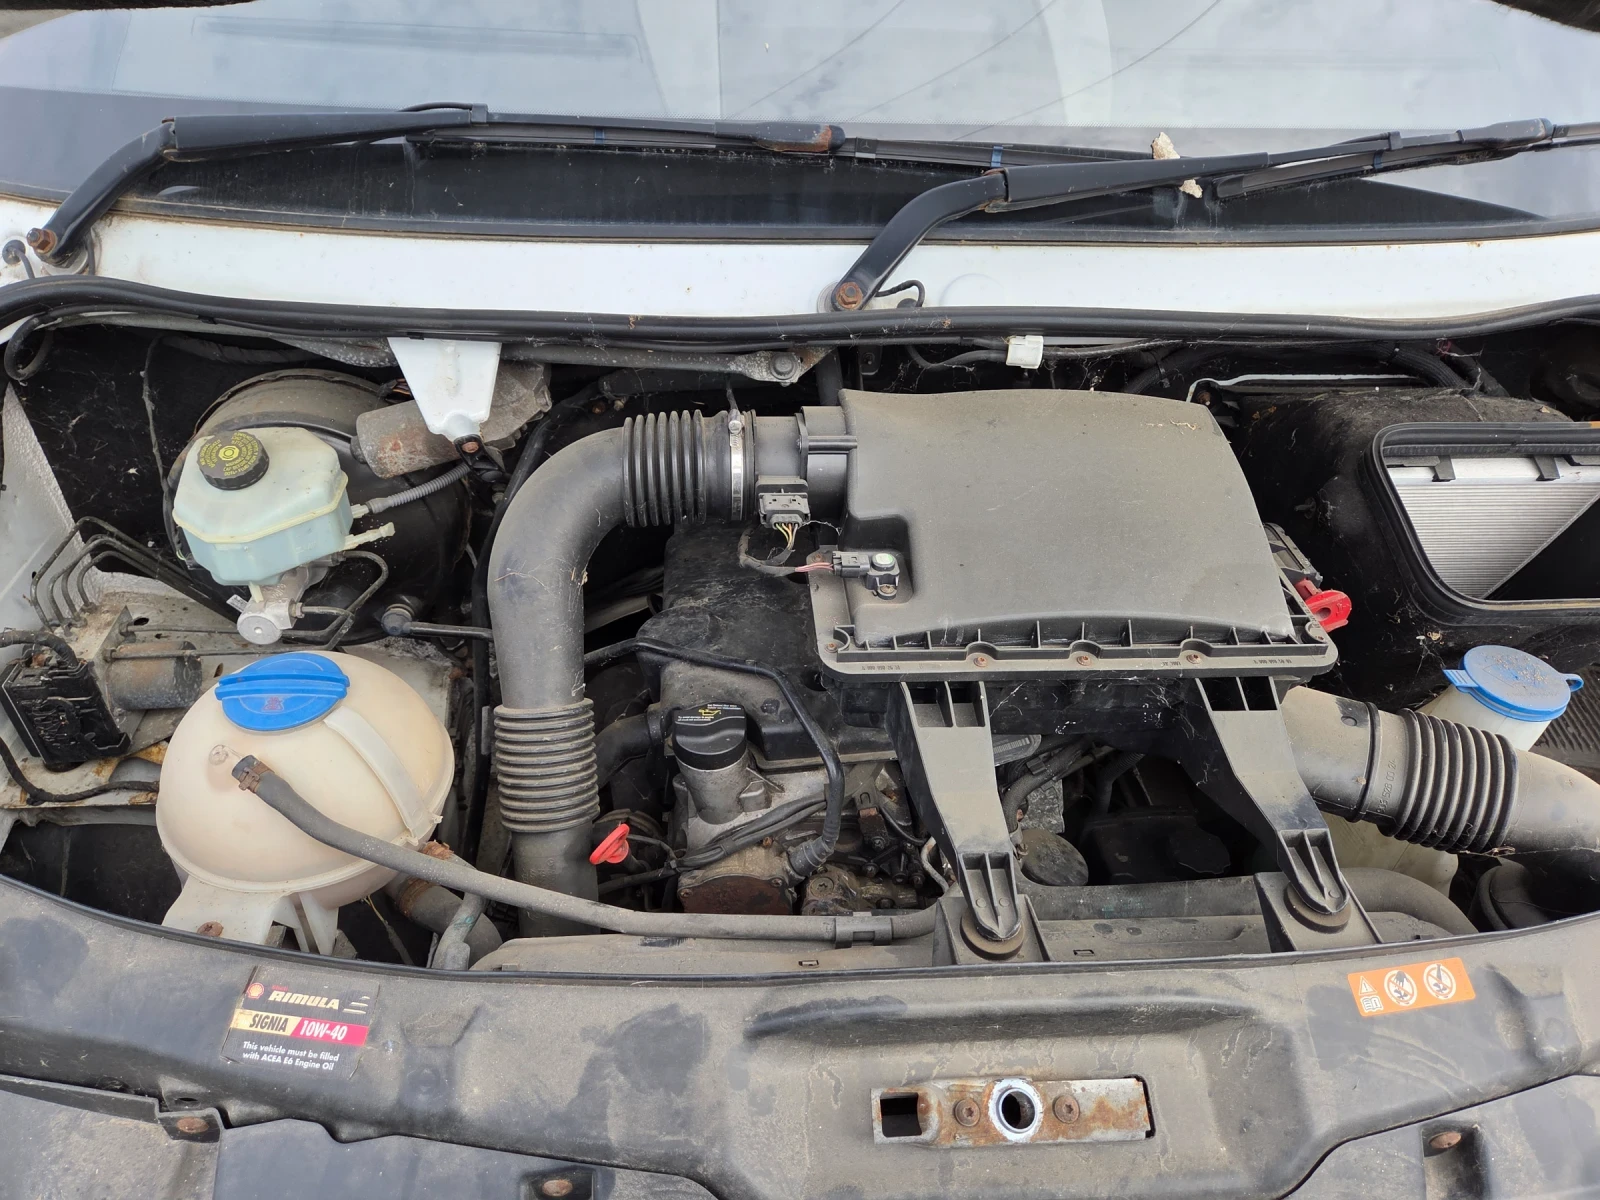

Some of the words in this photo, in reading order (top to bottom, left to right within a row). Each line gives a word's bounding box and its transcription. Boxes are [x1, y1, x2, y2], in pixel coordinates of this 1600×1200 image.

[268, 990, 340, 1010] RIMULA
[249, 1013, 289, 1032] SIGNIA
[299, 1020, 348, 1041] 10W-40
[242, 1051, 260, 1060] with
[261, 1053, 282, 1063] ACEA
[283, 1056, 293, 1065] E6
[294, 1059, 321, 1069] Engine
[322, 1062, 334, 1071] Oil
[243, 1041, 258, 1050] This
[260, 1044, 286, 1054] vehicle
[287, 1048, 307, 1057] must
[308, 1050, 318, 1059] be
[320, 1052, 340, 1062] filled
